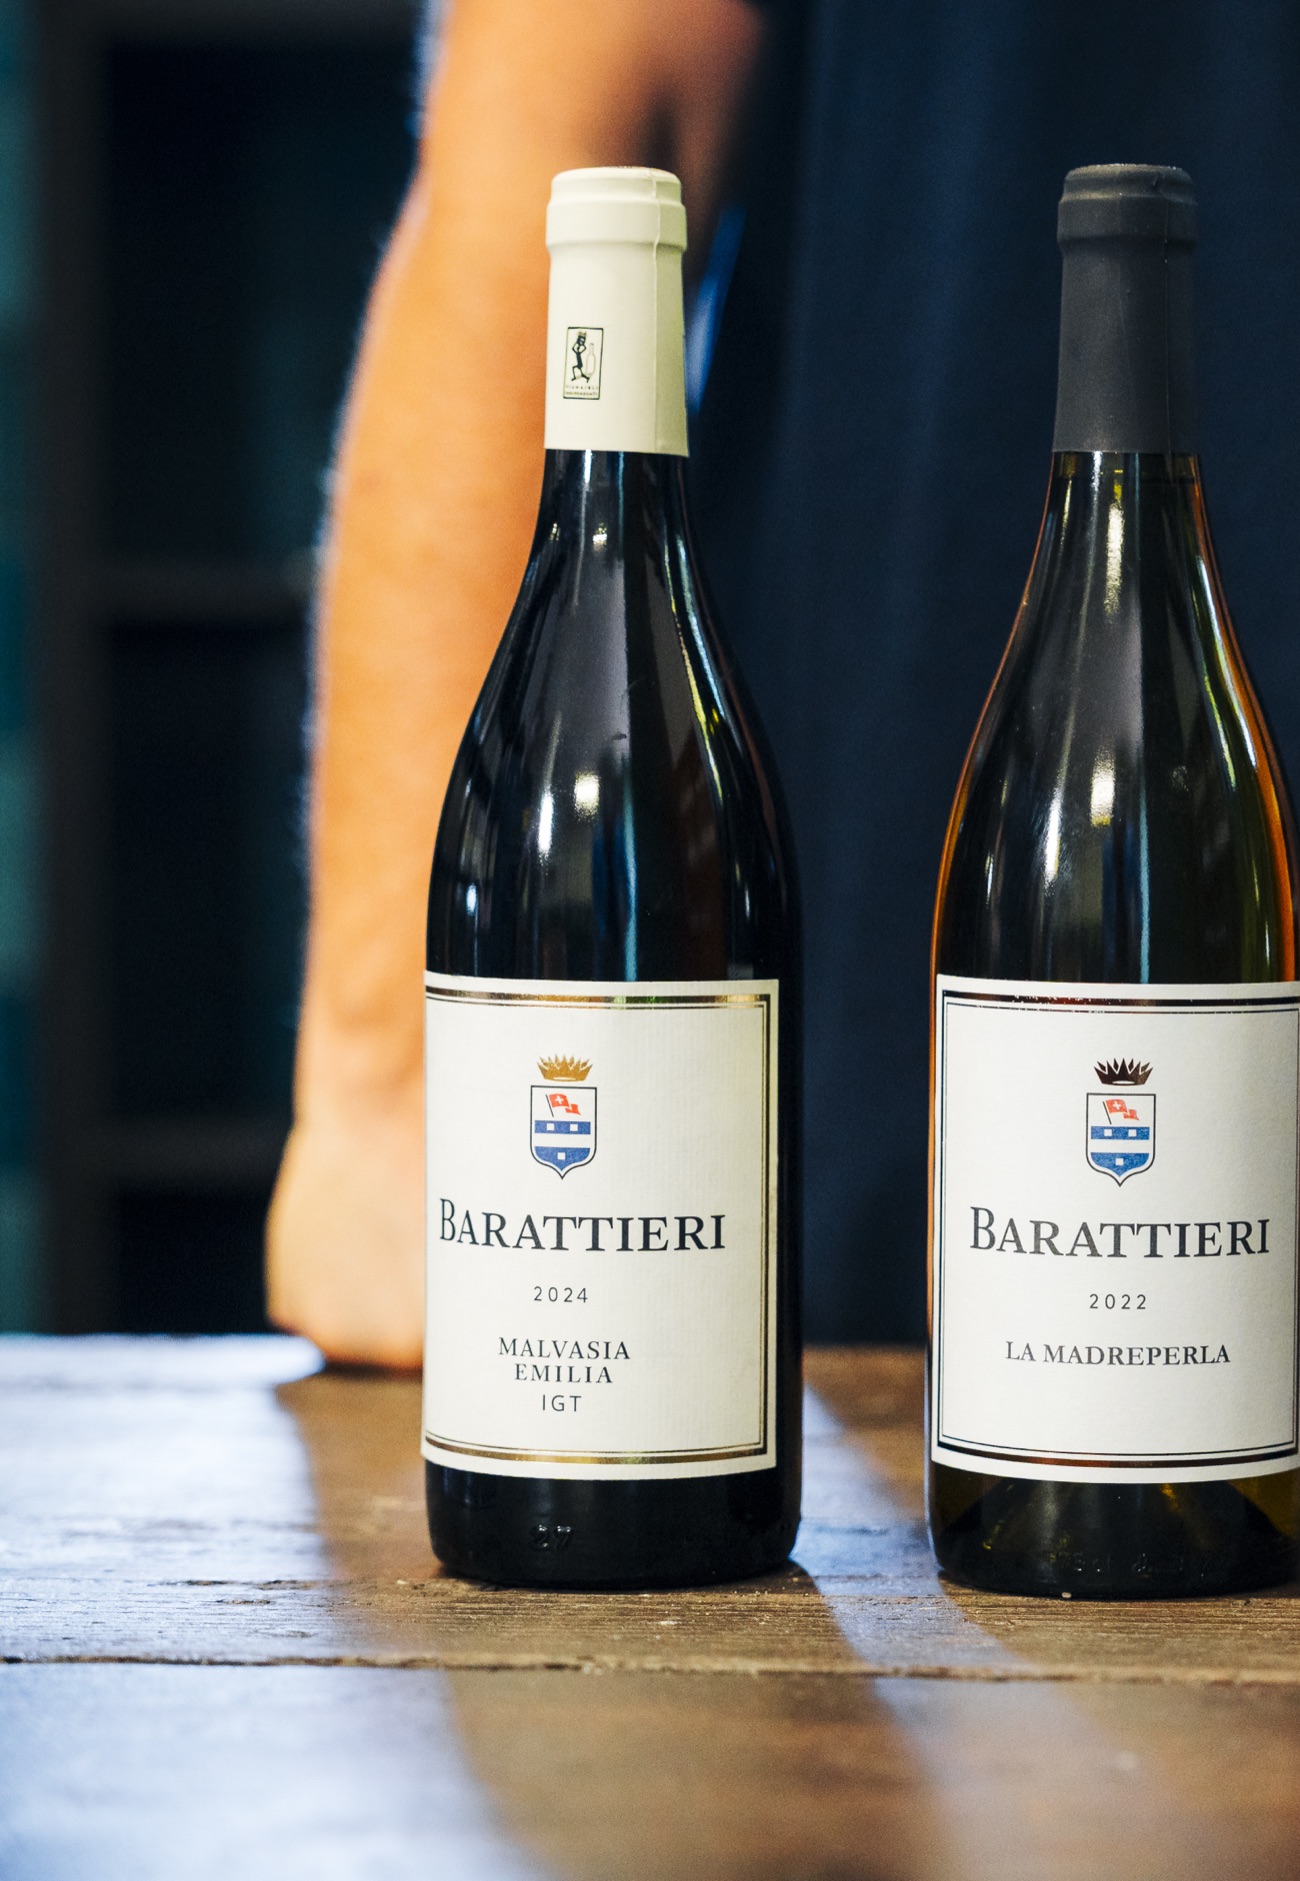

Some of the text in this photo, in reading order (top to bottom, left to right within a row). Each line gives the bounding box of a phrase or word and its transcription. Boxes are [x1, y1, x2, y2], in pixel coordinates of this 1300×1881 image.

[440, 1198, 726, 1252] BARATTIERI
[970, 1206, 1270, 1258] BARATTIERI
[533, 1286, 588, 1303] 2024
[1089, 1293, 1147, 1310] 2022
[499, 1337, 631, 1360] MALVASIA
[1006, 1341, 1231, 1366] LA MADREPERLA
[515, 1363, 613, 1384] EMILIA
[542, 1394, 582, 1412] IGT
